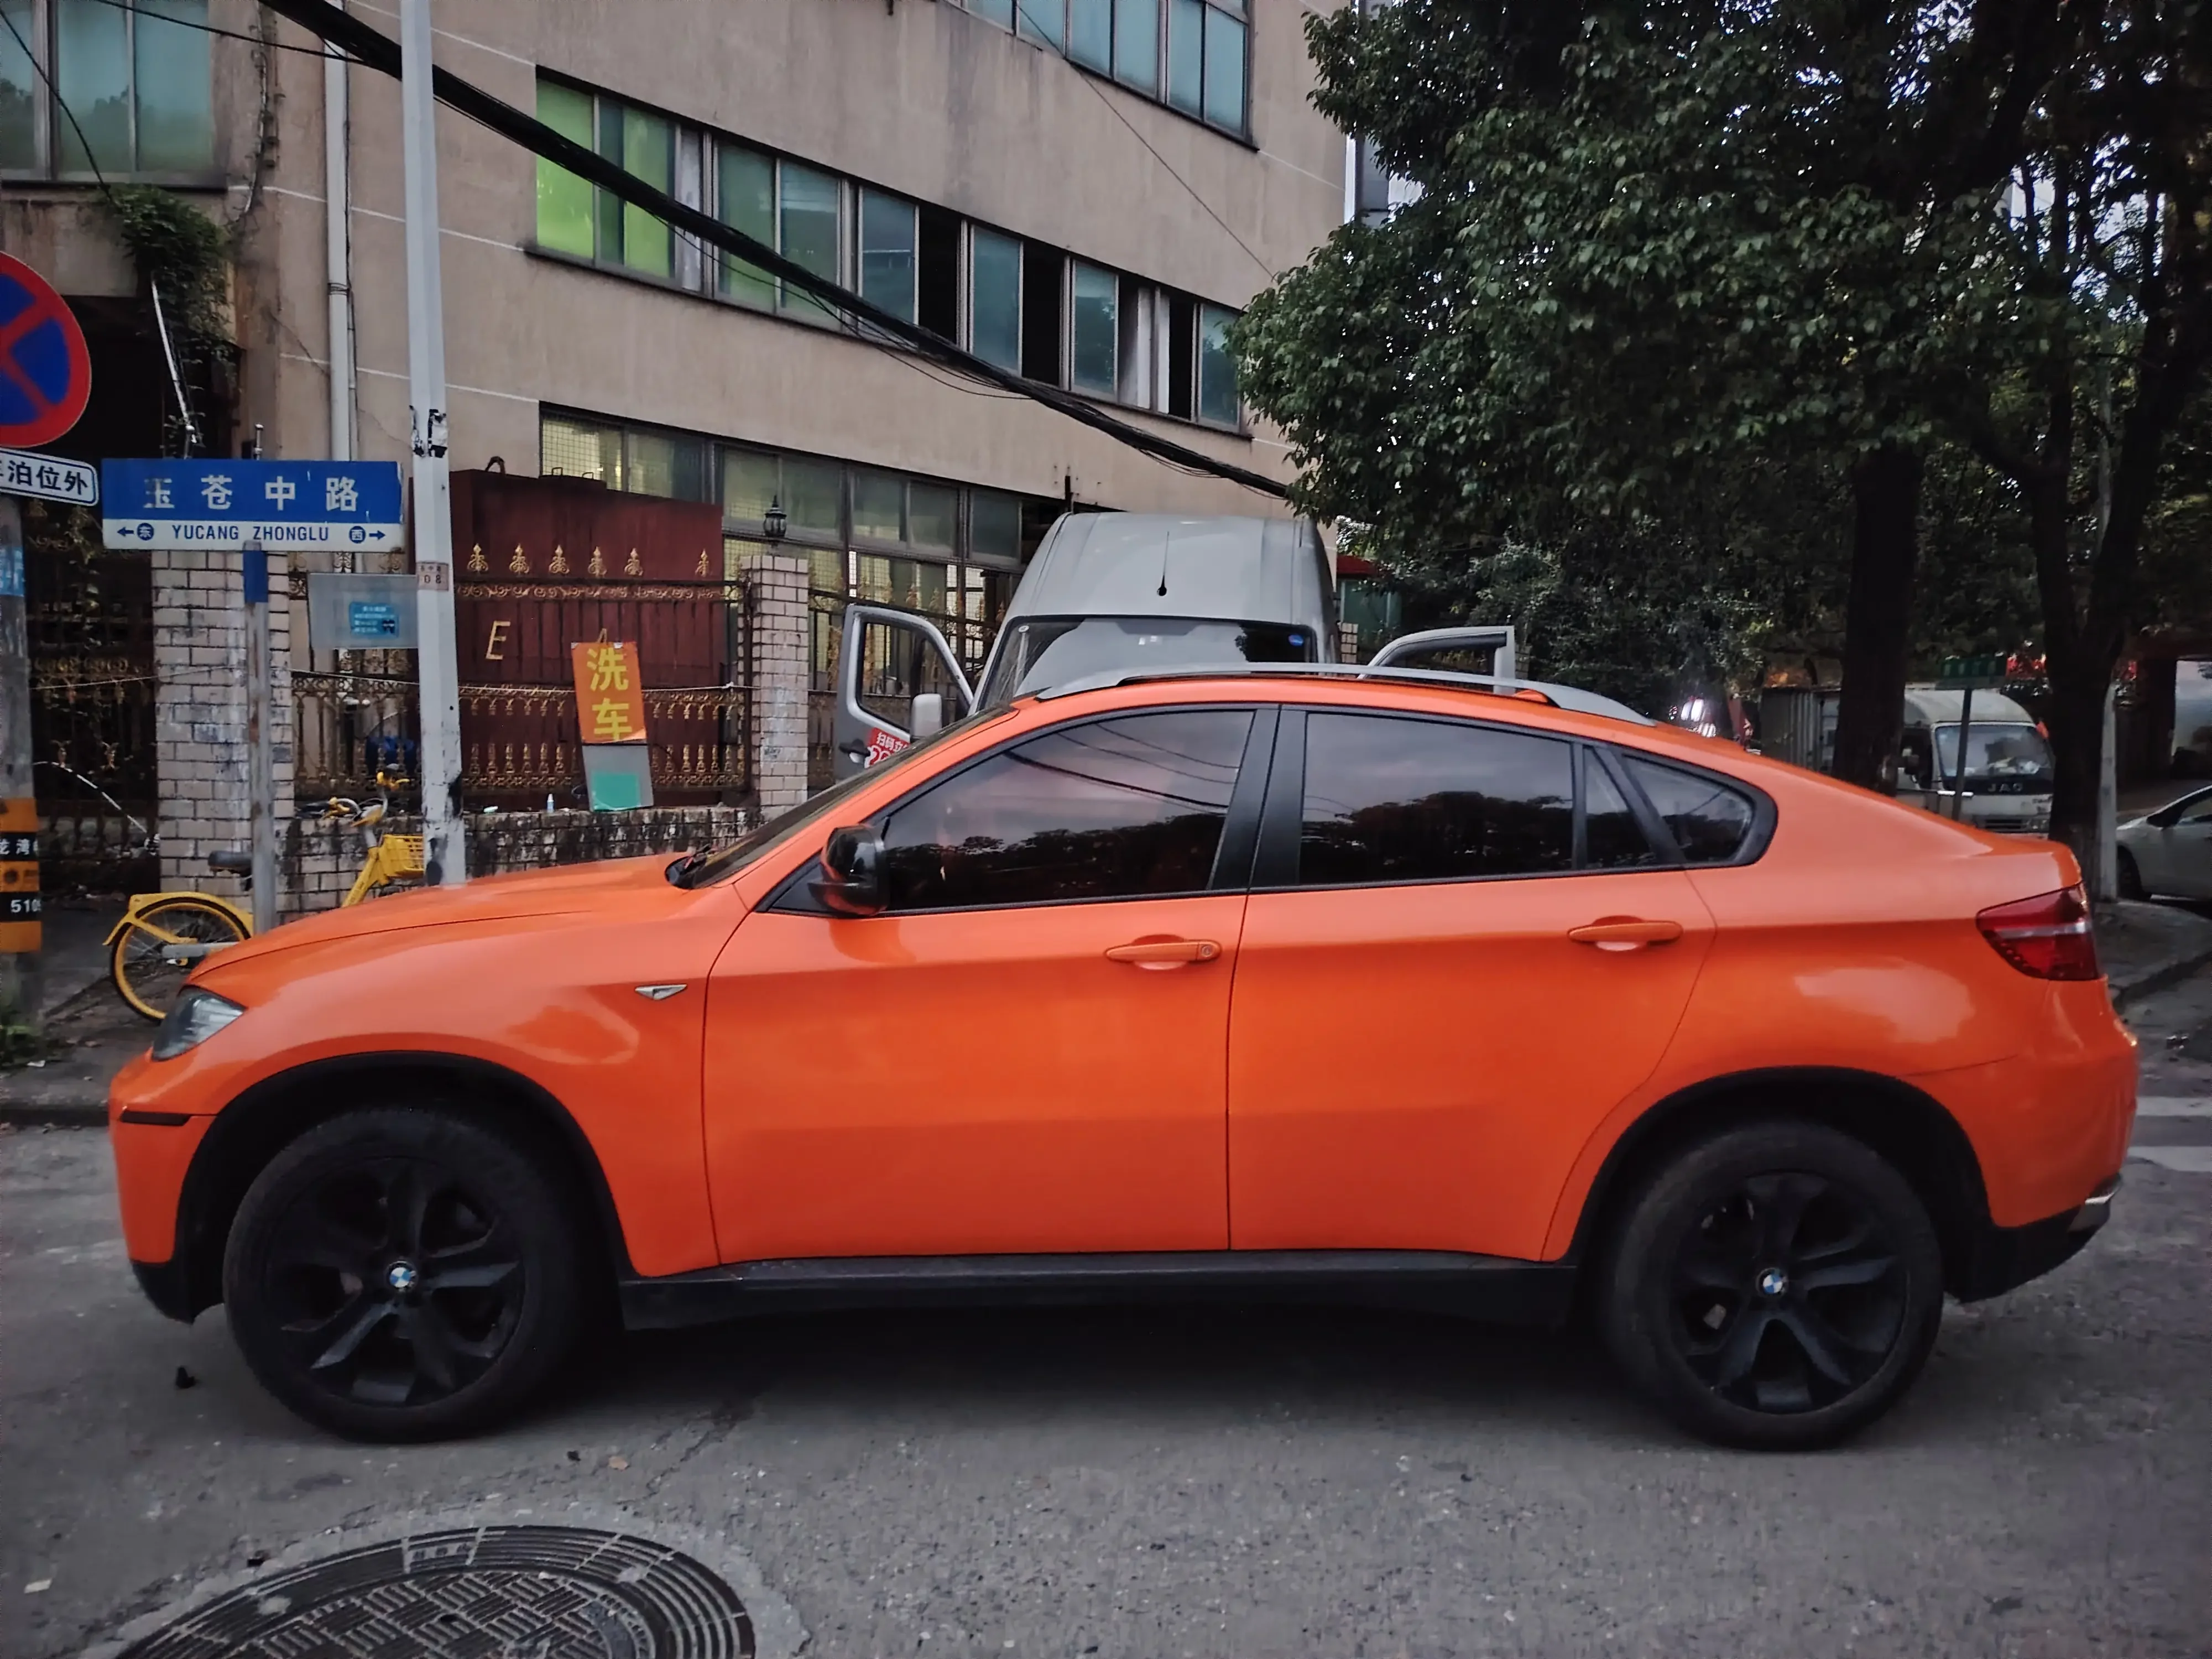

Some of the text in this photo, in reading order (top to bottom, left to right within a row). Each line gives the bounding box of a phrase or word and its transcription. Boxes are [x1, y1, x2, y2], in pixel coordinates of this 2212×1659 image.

[0, 460, 88, 495] 泊位外
[143, 474, 359, 512] 玉苍中路
[172, 525, 329, 540] YUCANG ZHONGLU
[350, 528, 364, 541] 西
[486, 620, 511, 660] E
[587, 647, 633, 741] 洗车
